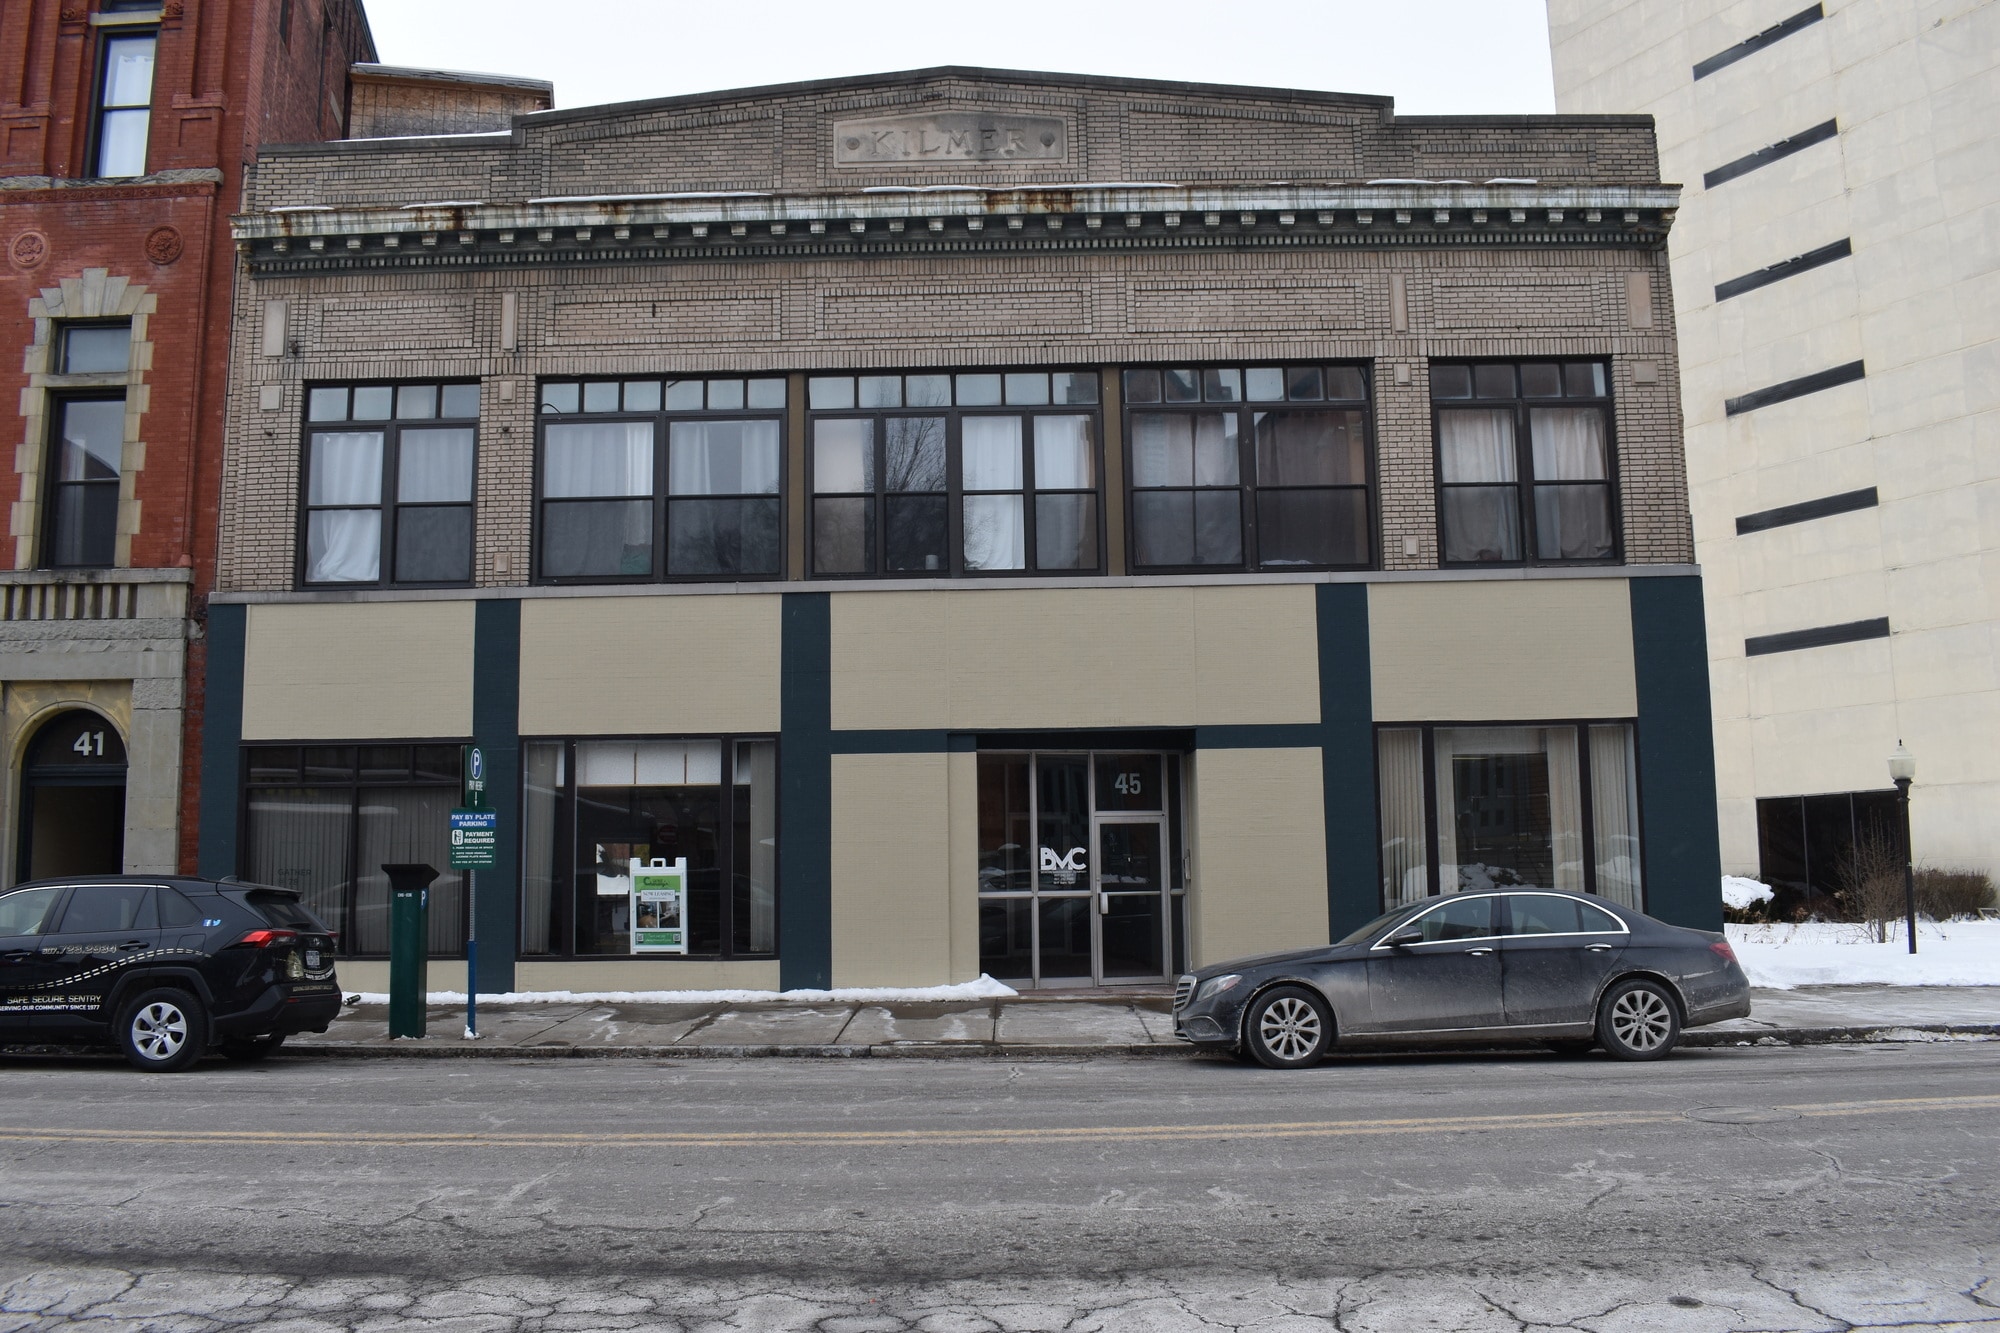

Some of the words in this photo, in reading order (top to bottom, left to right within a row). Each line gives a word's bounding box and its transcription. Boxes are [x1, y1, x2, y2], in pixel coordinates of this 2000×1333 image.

[871, 128, 1027, 156] KILMER
[73, 731, 104, 756] 41
[1114, 773, 1141, 795] 45
[1040, 847, 1087, 870] BMC
[277, 868, 312, 876] GATHER
